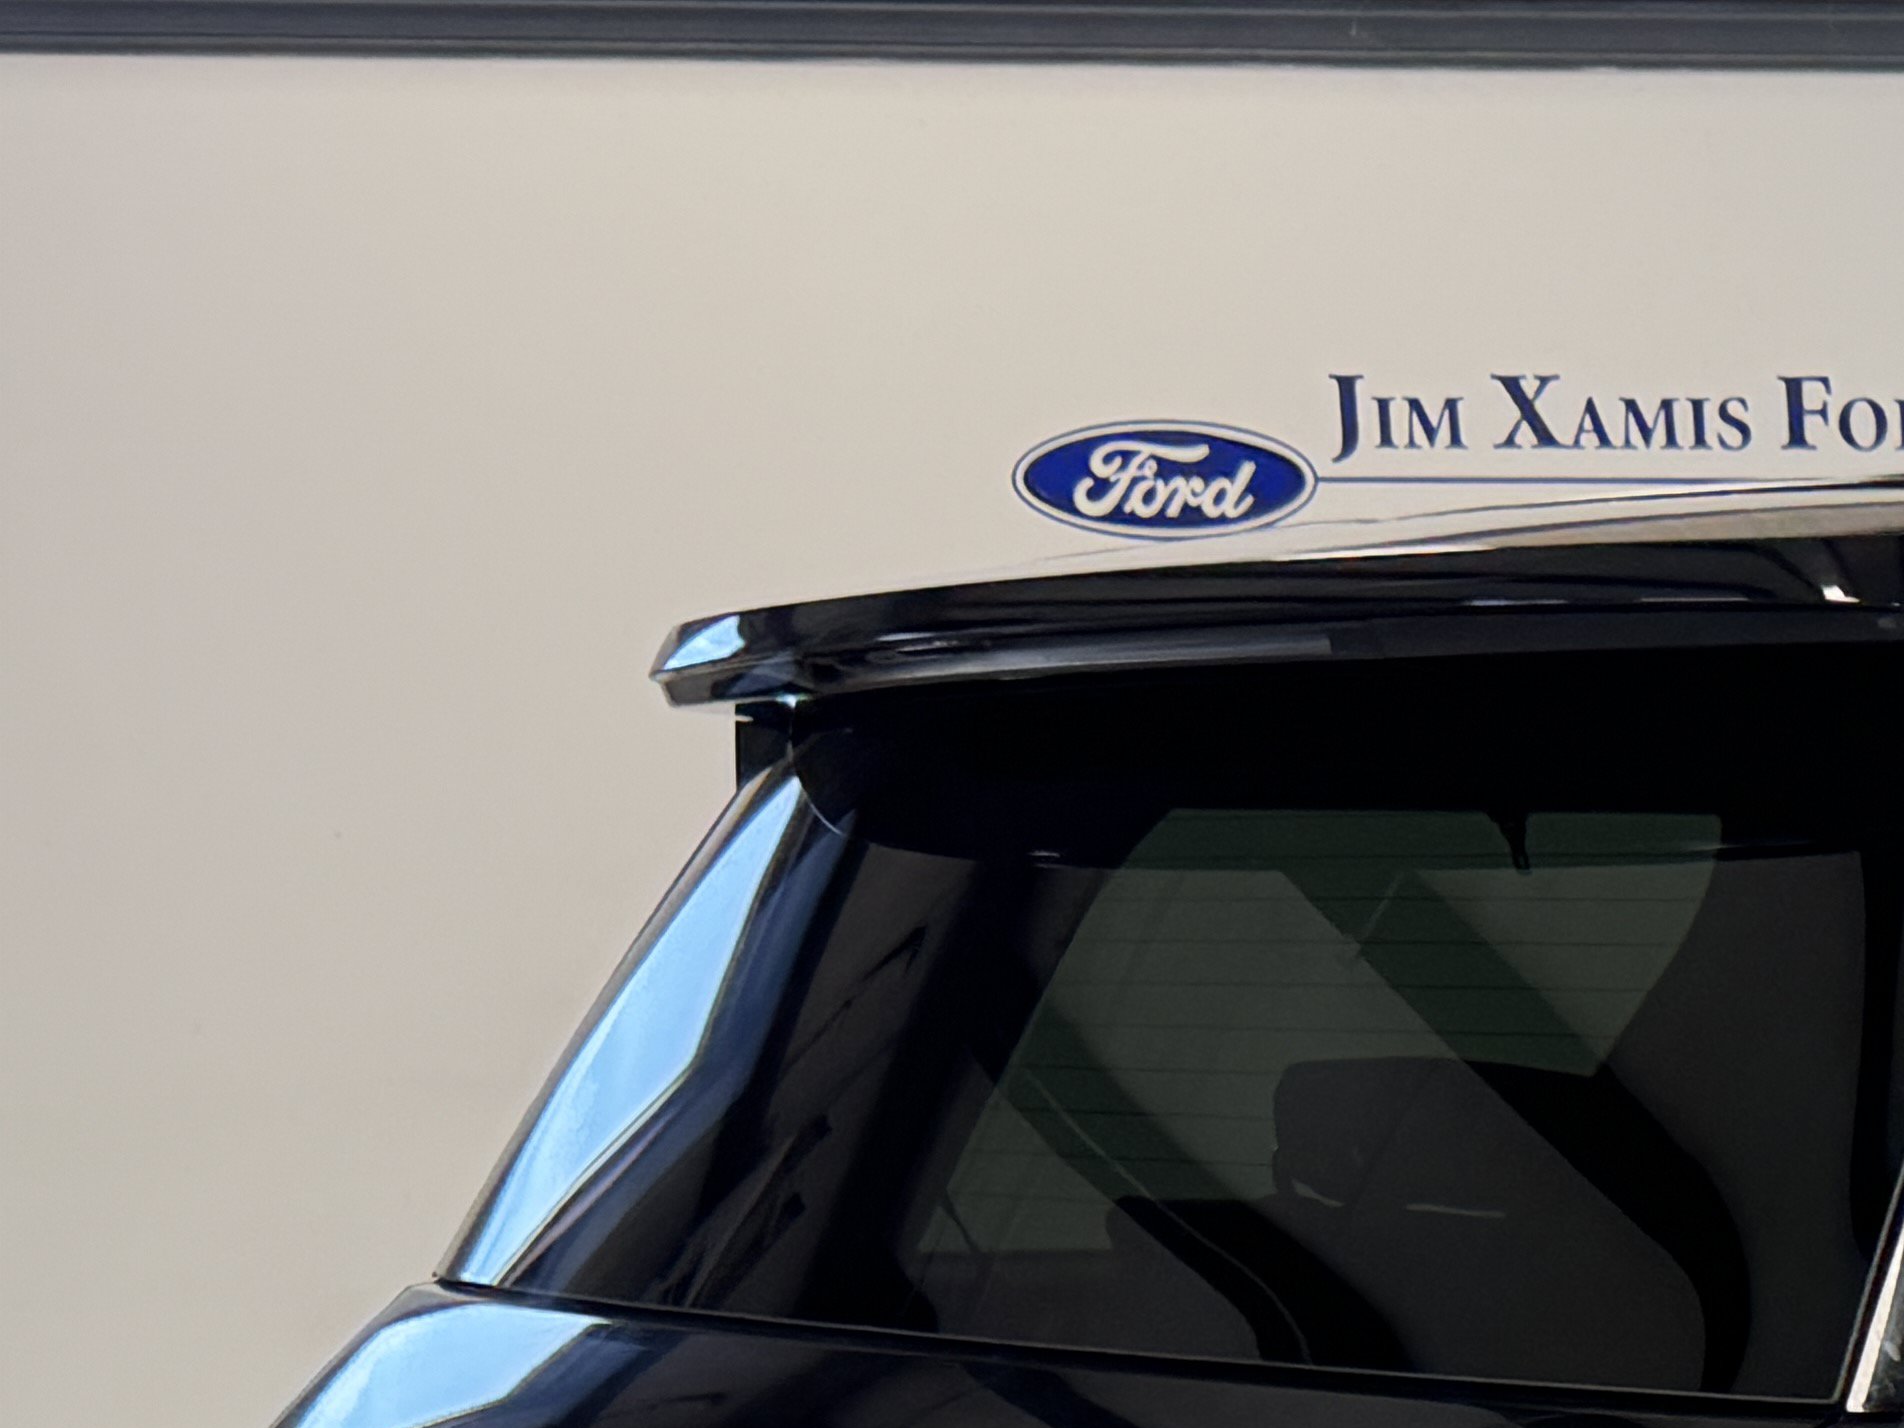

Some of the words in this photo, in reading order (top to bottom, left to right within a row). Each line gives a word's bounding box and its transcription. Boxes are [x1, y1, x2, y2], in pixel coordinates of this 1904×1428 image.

[1329, 373, 1463, 462] JIM
[1490, 373, 1752, 452] XAMIS
[1073, 440, 1256, 519] Ford
